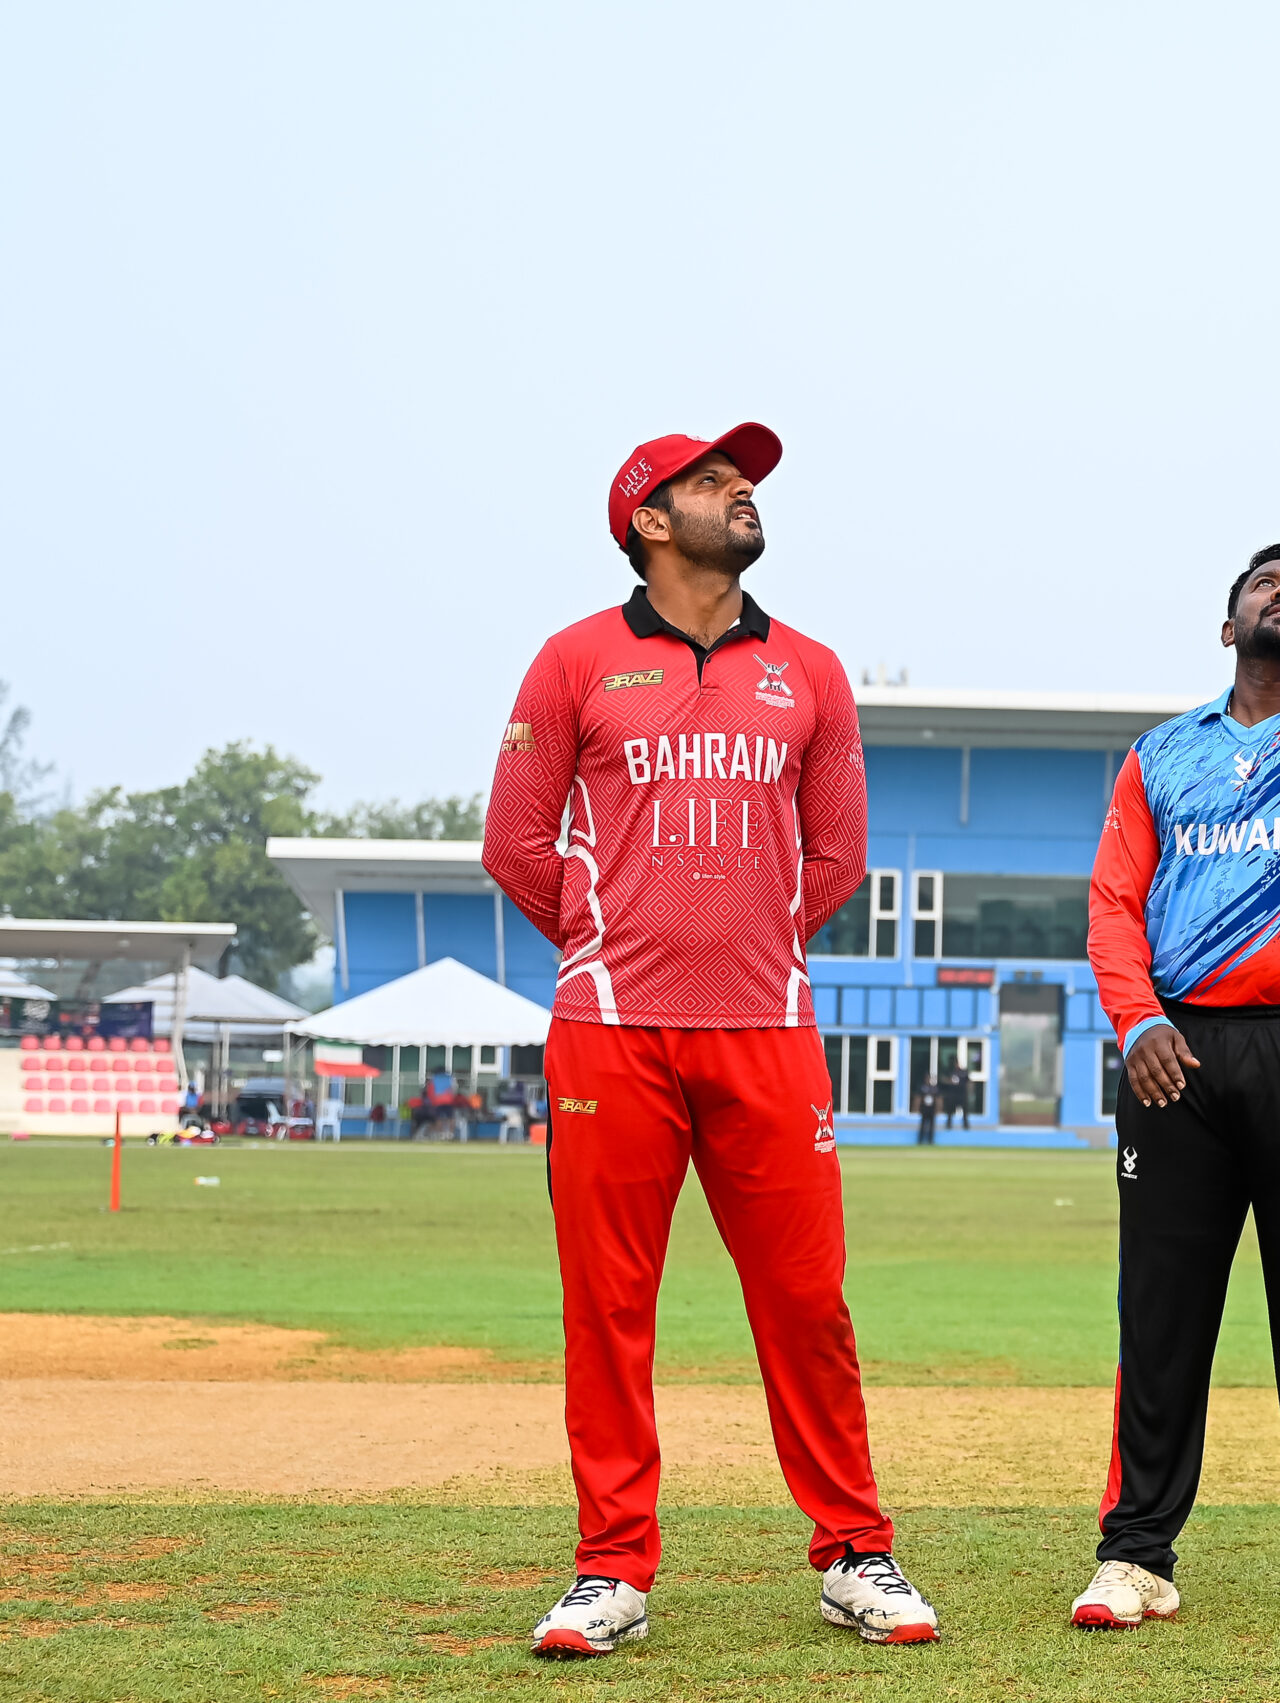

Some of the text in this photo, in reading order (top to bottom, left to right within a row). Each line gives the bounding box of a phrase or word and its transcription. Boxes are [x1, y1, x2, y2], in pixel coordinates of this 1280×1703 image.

[602, 669, 664, 691] BRAVE
[623, 733, 788, 785] BAHRAIN
[650, 797, 764, 850] LIFE
[557, 1097, 598, 1115] BRAVE
